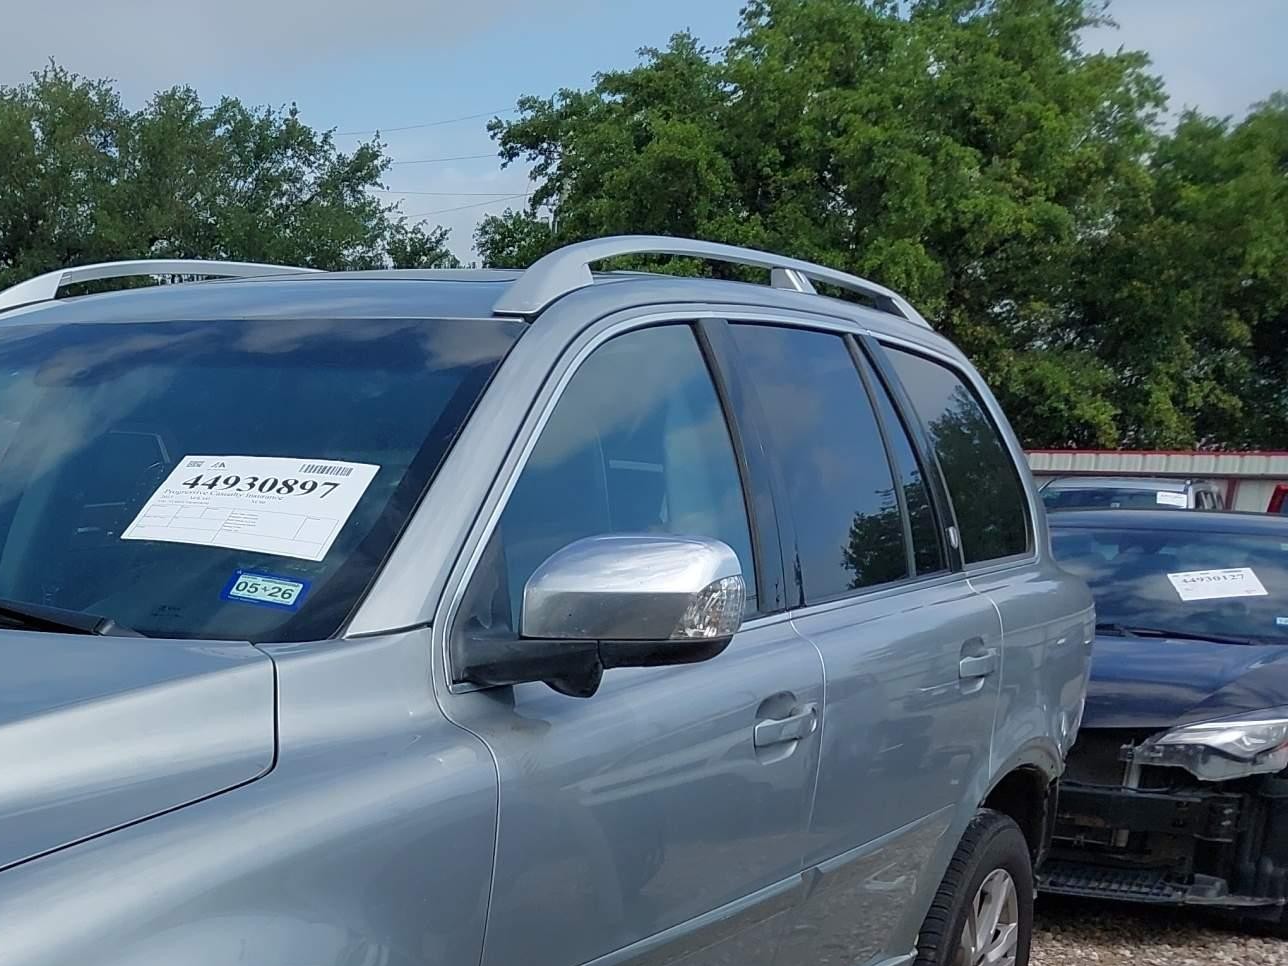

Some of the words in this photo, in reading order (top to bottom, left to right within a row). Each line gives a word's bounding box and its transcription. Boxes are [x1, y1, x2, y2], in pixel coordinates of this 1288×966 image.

[163, 488, 208, 497] Progressive
[210, 490, 243, 499] Casualty
[182, 473, 341, 499] 44930897
[236, 580, 261, 594] 05
[267, 586, 294, 600] 26
